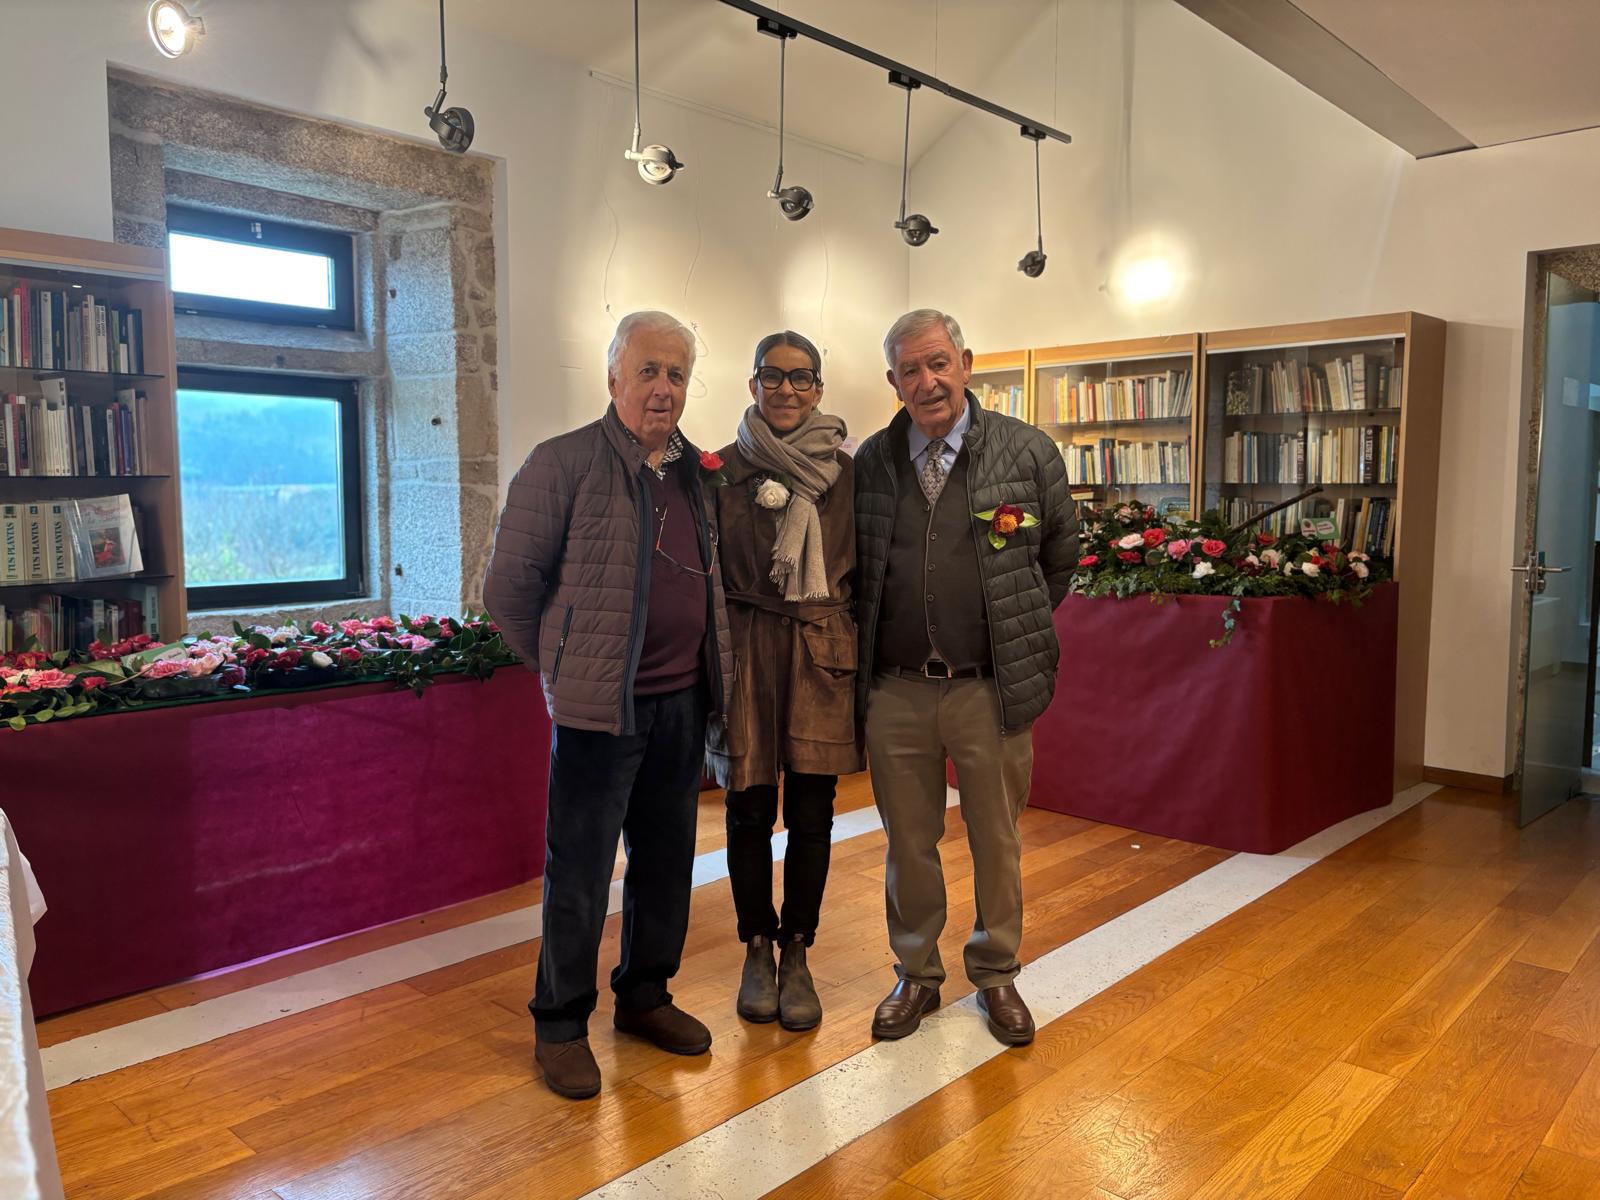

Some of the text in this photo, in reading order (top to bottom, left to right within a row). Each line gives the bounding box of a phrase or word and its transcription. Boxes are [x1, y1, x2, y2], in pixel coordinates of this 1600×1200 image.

[7, 522, 15, 555] PLANTAS
[55, 521, 63, 553] PLANTAS
[8, 557, 16, 571] TUS
